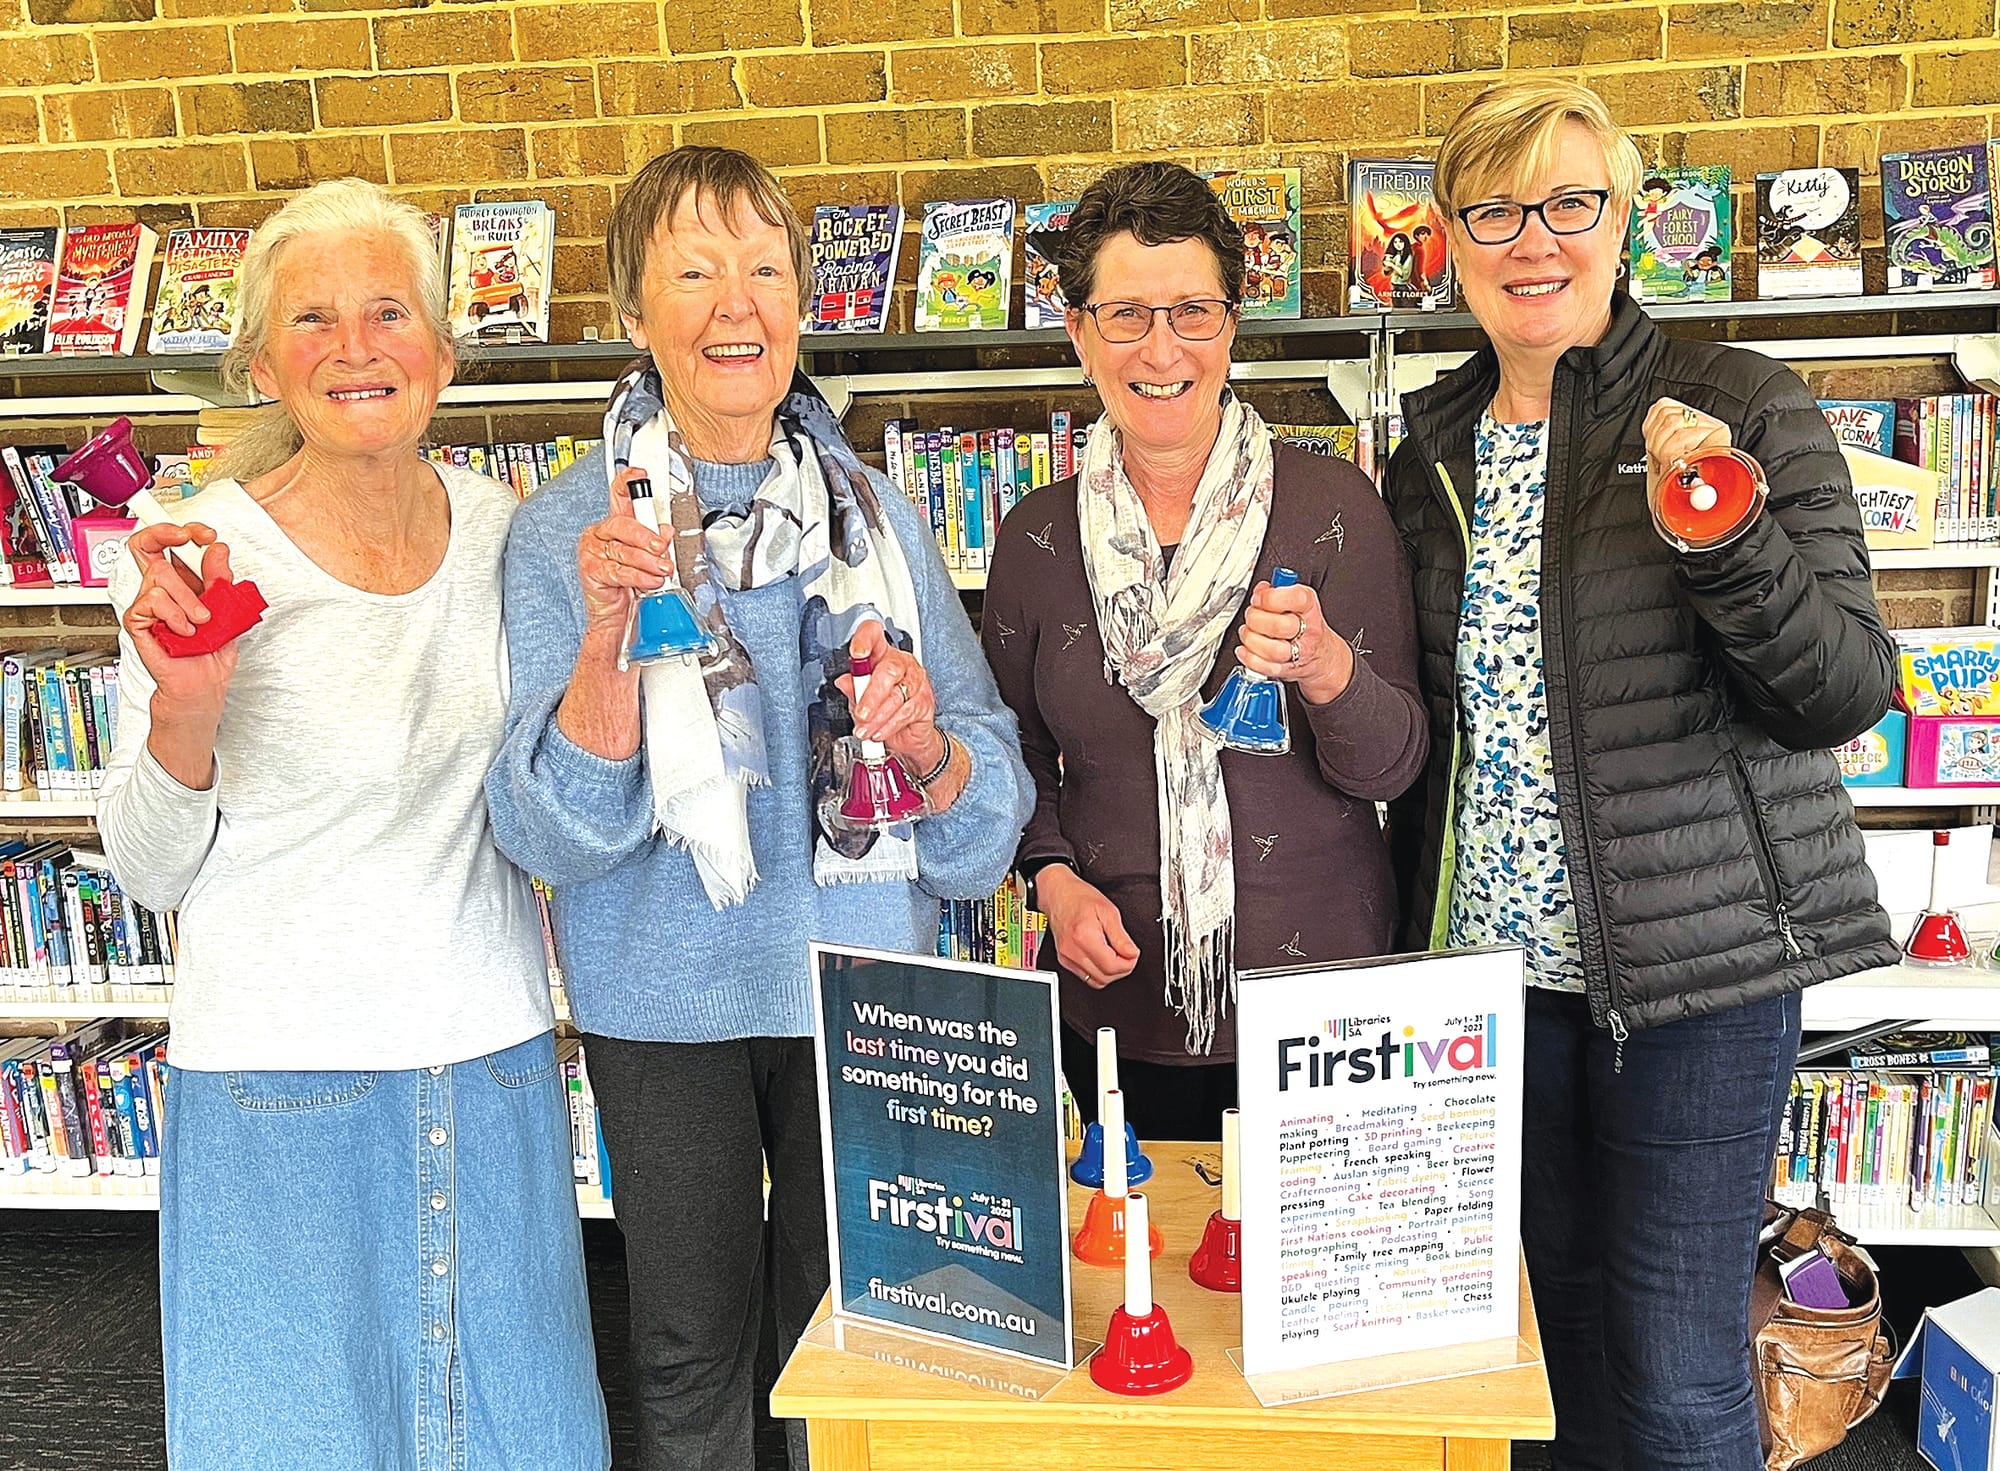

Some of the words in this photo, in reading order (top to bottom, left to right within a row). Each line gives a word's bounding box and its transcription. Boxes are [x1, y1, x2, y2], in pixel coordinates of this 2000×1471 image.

[1899, 154, 1974, 180] DRAGON
[1226, 177, 1266, 188] WORLD'S
[1369, 171, 1433, 192] FIREBIR
[1787, 178, 1830, 197] Kitty
[1905, 174, 1971, 197] STORM
[1217, 187, 1280, 206] WORST
[1379, 192, 1429, 209] SONG
[928, 210, 969, 240] SECRET
[971, 203, 1006, 225] BEAST
[1238, 205, 1280, 215] MACHINE
[1667, 209, 1694, 221] FAIRY
[472, 217, 523, 231] BREAKS
[963, 224, 986, 233] CLUB
[1662, 221, 1698, 234] FOREST
[175, 231, 244, 249] FAMILY
[811, 232, 892, 267] POWERED
[1662, 234, 1698, 246] SCHOOL
[168, 258, 241, 275] DISASTERS
[820, 260, 876, 280] Racing
[816, 271, 880, 295] ARAVAN
[1825, 408, 1872, 428] DAVE
[191, 448, 216, 460] ANDY
[1856, 489, 1913, 508] GHTIEST
[1913, 650, 2000, 676] SMARTY
[1931, 668, 1987, 691] PUP
[852, 1001, 923, 1033] When
[926, 1017, 975, 1041] was
[977, 1021, 1018, 1047] the
[1348, 1015, 1391, 1027] Libraries
[1348, 1028, 1362, 1037] SA
[1444, 1017, 1462, 1027] July
[1463, 1024, 1483, 1032] 2023
[846, 1030, 885, 1057] last
[888, 1038, 940, 1066] time
[943, 1051, 986, 1074] you
[990, 1054, 1029, 1081] did
[1279, 1013, 1496, 1092] Firstival
[1858, 1057, 1885, 1068] CROSS
[1887, 1054, 1917, 1065] BONES
[841, 1065, 958, 1106] something
[962, 1081, 995, 1107] for
[998, 1088, 1039, 1115] the
[1413, 1081, 1426, 1090] Try
[1428, 1074, 1473, 1087] something
[886, 1098, 927, 1126] first
[931, 1106, 994, 1138] time?
[1280, 1114, 1334, 1127] Animating
[1362, 1104, 1417, 1117] Meditating
[1444, 1095, 1496, 1107] Chocolate
[1280, 1128, 1318, 1139] making
[1336, 1118, 1404, 1132] Breadmaking
[1449, 1108, 1496, 1119] bombing
[1280, 1141, 1306, 1151] Plant
[1309, 1137, 1348, 1150] potting
[1364, 1132, 1378, 1141] 3D
[1380, 1128, 1422, 1141] printing
[1437, 1119, 1495, 1132] Beekeeping
[1280, 1149, 1350, 1164] Puppeteering
[1368, 1141, 1398, 1153] Board
[1403, 1137, 1442, 1151] gaming
[1344, 1155, 1378, 1167] French
[1384, 1150, 1431, 1164] speaking
[1452, 1143, 1495, 1153] Creative
[1280, 1177, 1316, 1188] coding
[1333, 1170, 1368, 1180] Auslan
[1372, 1165, 1410, 1177] signing
[1427, 1160, 1449, 1168] Beer
[1453, 1154, 1494, 1165] brewing
[1280, 1183, 1360, 1199] Crafternooning
[1412, 1172, 1446, 1183] dyeing
[1462, 1167, 1494, 1176] Flower
[1280, 1199, 1325, 1214] pressing
[1348, 1192, 1373, 1202] Cake
[1379, 1185, 1435, 1198] decorating
[1458, 1178, 1494, 1188] Science
[1280, 1207, 1356, 1223] experimenting
[1378, 1202, 1394, 1210] Tea
[1402, 1195, 1446, 1207] blending
[1469, 1189, 1494, 1199] Song
[868, 1178, 1023, 1251] Firstival
[1280, 1224, 1318, 1234] writing
[1424, 1207, 1453, 1216] Paper
[1458, 1201, 1493, 1211] folding
[1280, 1237, 1303, 1246] First
[1308, 1232, 1346, 1241] Nations
[1350, 1226, 1392, 1237] cooking
[1408, 1217, 1447, 1229] Portrait
[1452, 1212, 1493, 1226] painting
[936, 1236, 951, 1249] Try
[952, 1241, 1000, 1261] something
[1280, 1242, 1358, 1258] Photographing
[1381, 1231, 1438, 1244] Podcasting
[1334, 1251, 1367, 1262] Family
[1372, 1249, 1393, 1257] tree
[1398, 1242, 1444, 1254] mapping
[1464, 1234, 1493, 1245] Public
[1281, 1269, 1327, 1283] speaking
[1344, 1263, 1371, 1274] Spice
[1375, 1258, 1409, 1268] mixing
[1426, 1251, 1450, 1262] Book
[1455, 1247, 1493, 1258] binding
[1281, 1292, 1318, 1304] Ukulele
[1322, 1288, 1360, 1301] playing
[1378, 1276, 1437, 1290] Community
[1441, 1270, 1493, 1285] gardening
[1314, 1276, 1360, 1290] questing
[867, 1277, 1037, 1336] firstival.com.au
[1328, 1298, 1368, 1312] pouring
[1402, 1290, 1433, 1298] Henna
[1444, 1281, 1492, 1293] tattooing
[1463, 1293, 1492, 1302] Chess
[1282, 1329, 1319, 1342] playing
[1333, 1320, 1359, 1332] Scarf
[1362, 1316, 1402, 1327] knitting
[1451, 1304, 1492, 1314] weaving
